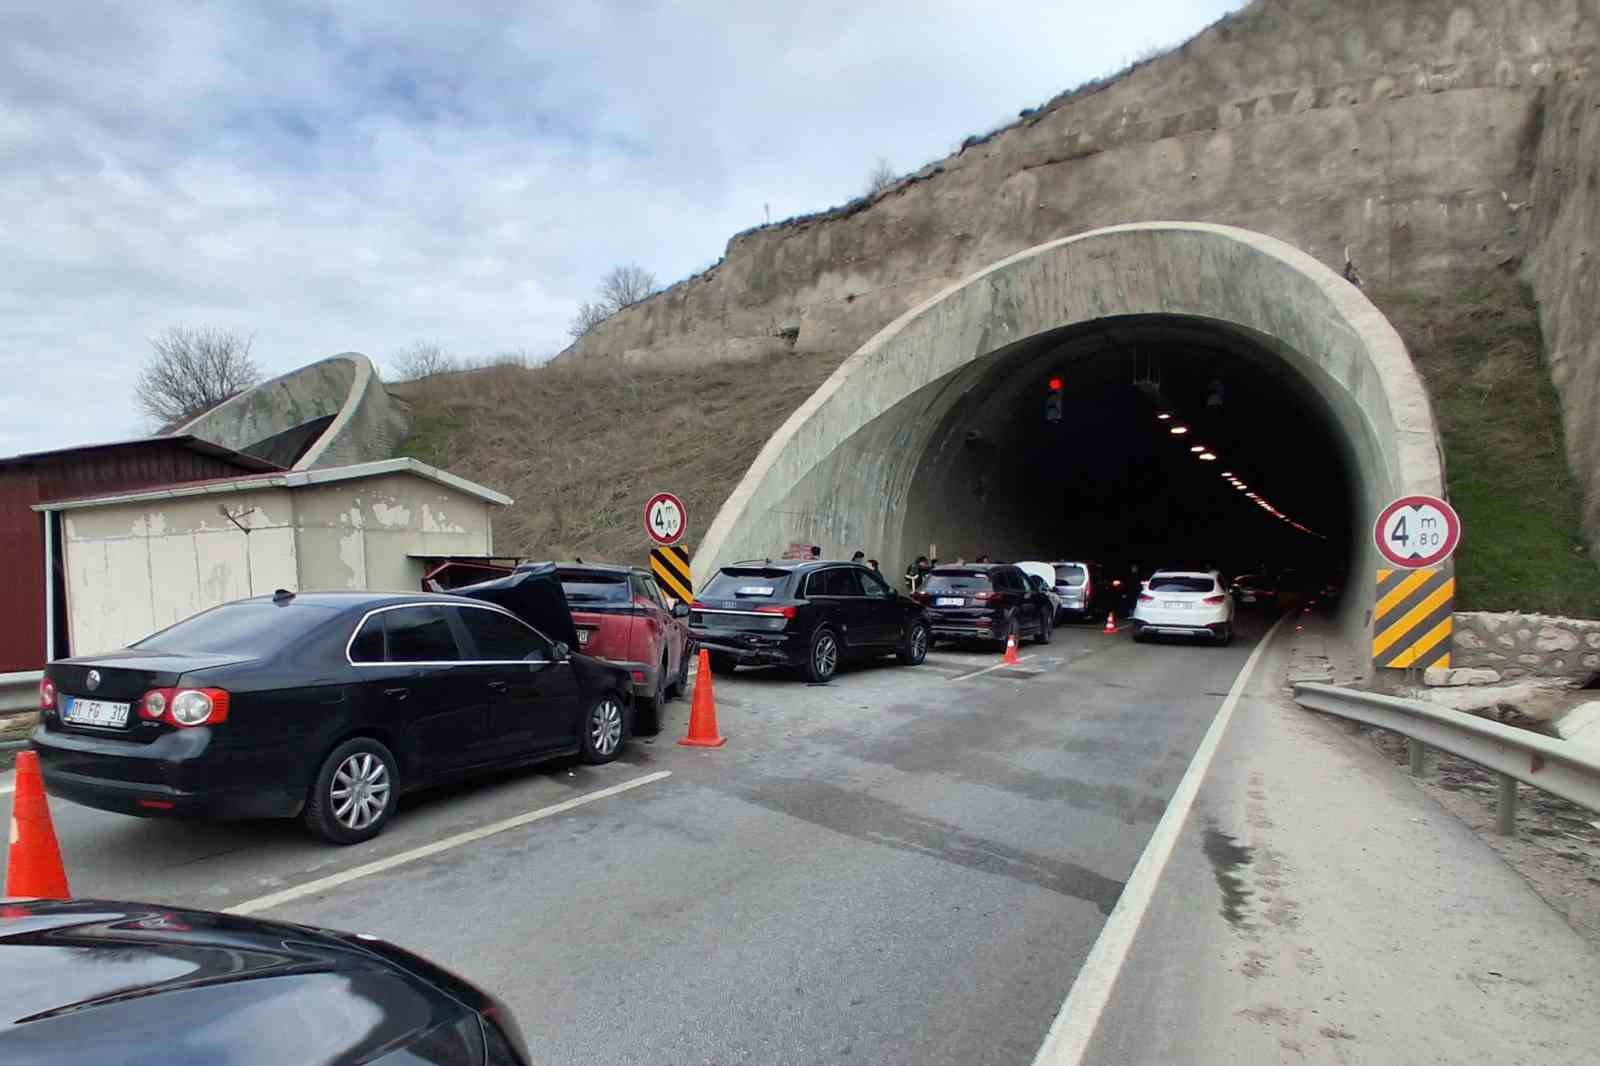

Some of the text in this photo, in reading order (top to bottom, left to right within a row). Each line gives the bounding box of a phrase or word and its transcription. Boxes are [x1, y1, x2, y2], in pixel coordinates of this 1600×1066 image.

[655, 508, 664, 530] 4
[1421, 517, 1438, 529] m
[1391, 515, 1409, 547] 4
[73, 701, 129, 722] 01 FG 312
